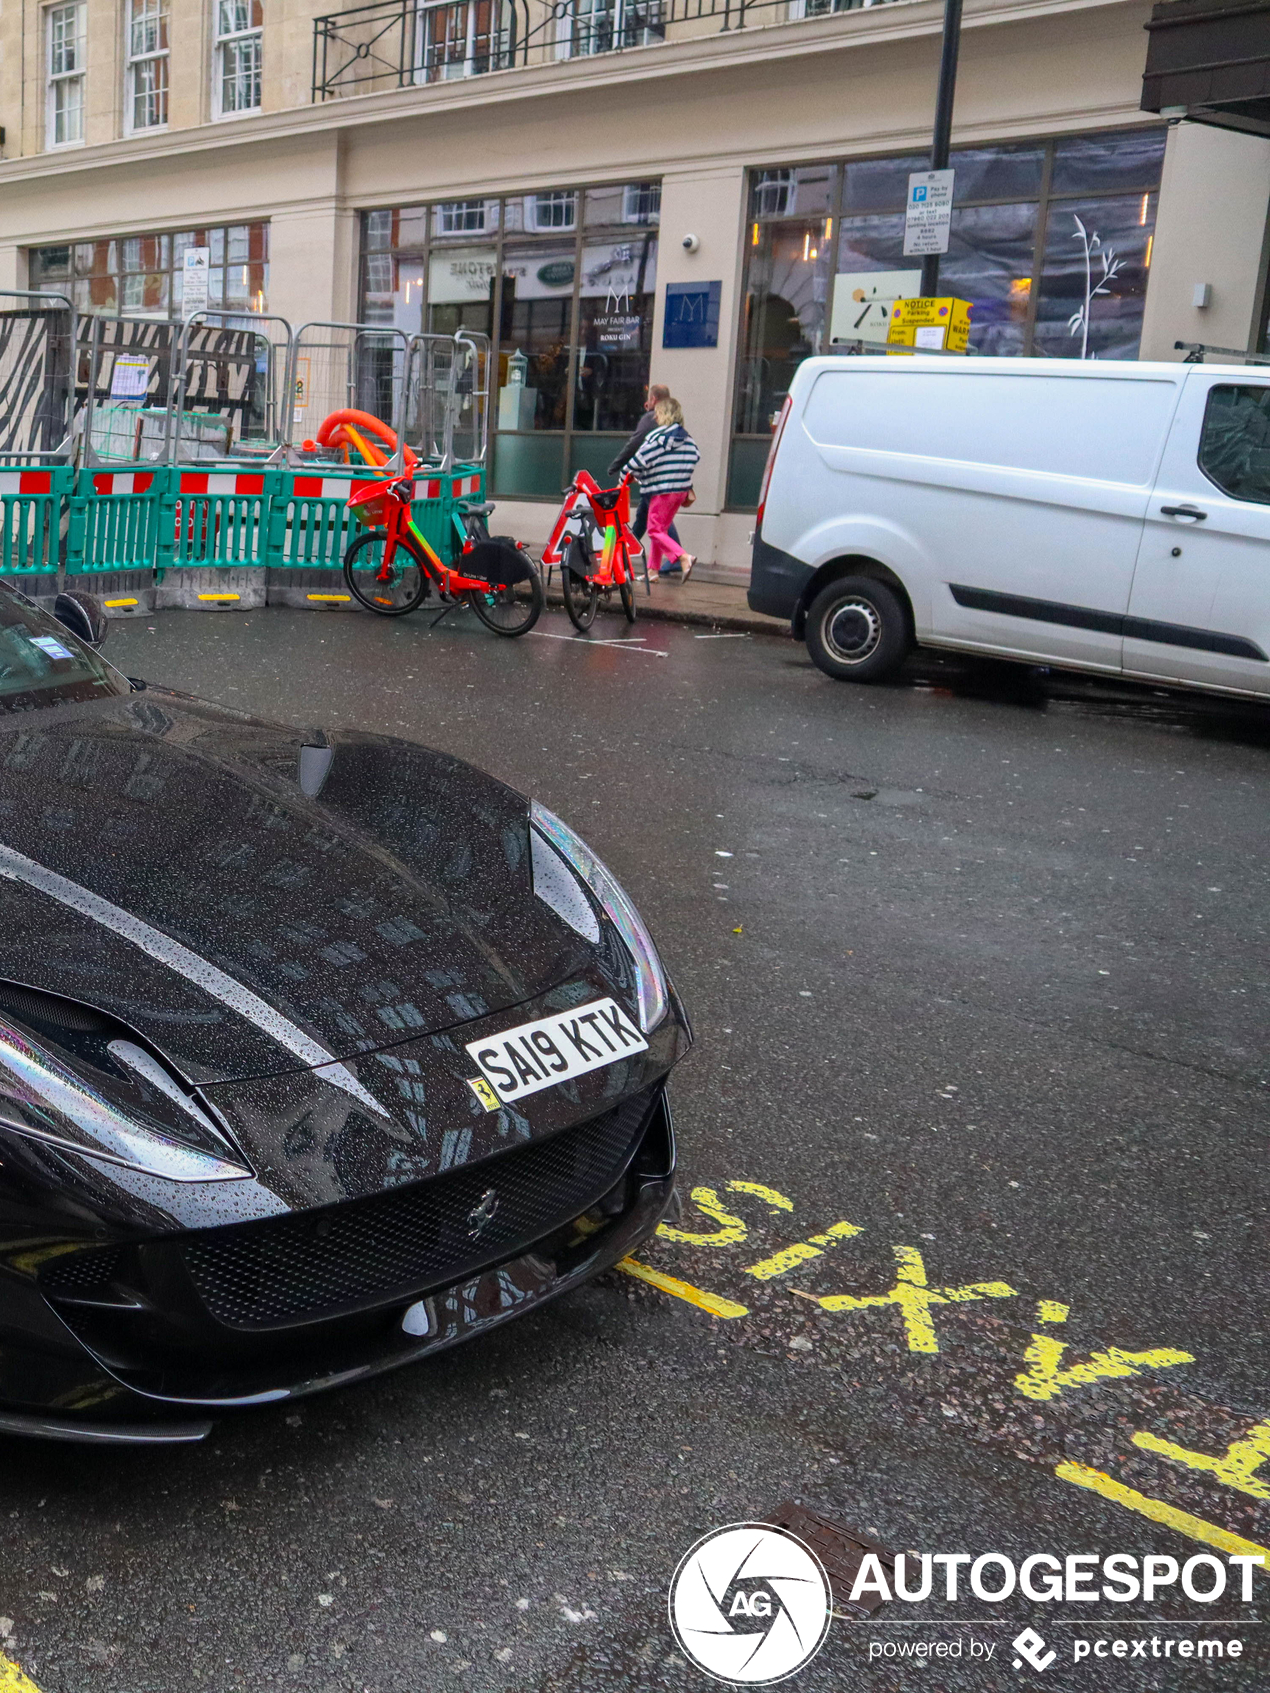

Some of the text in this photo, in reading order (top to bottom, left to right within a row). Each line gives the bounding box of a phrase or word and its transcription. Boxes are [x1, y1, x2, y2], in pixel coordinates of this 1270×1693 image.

[905, 300, 935, 308] NOTICE
[610, 316, 625, 324] FAIR
[626, 316, 640, 324] BAR
[478, 1006, 642, 1092] SA19 KTK
